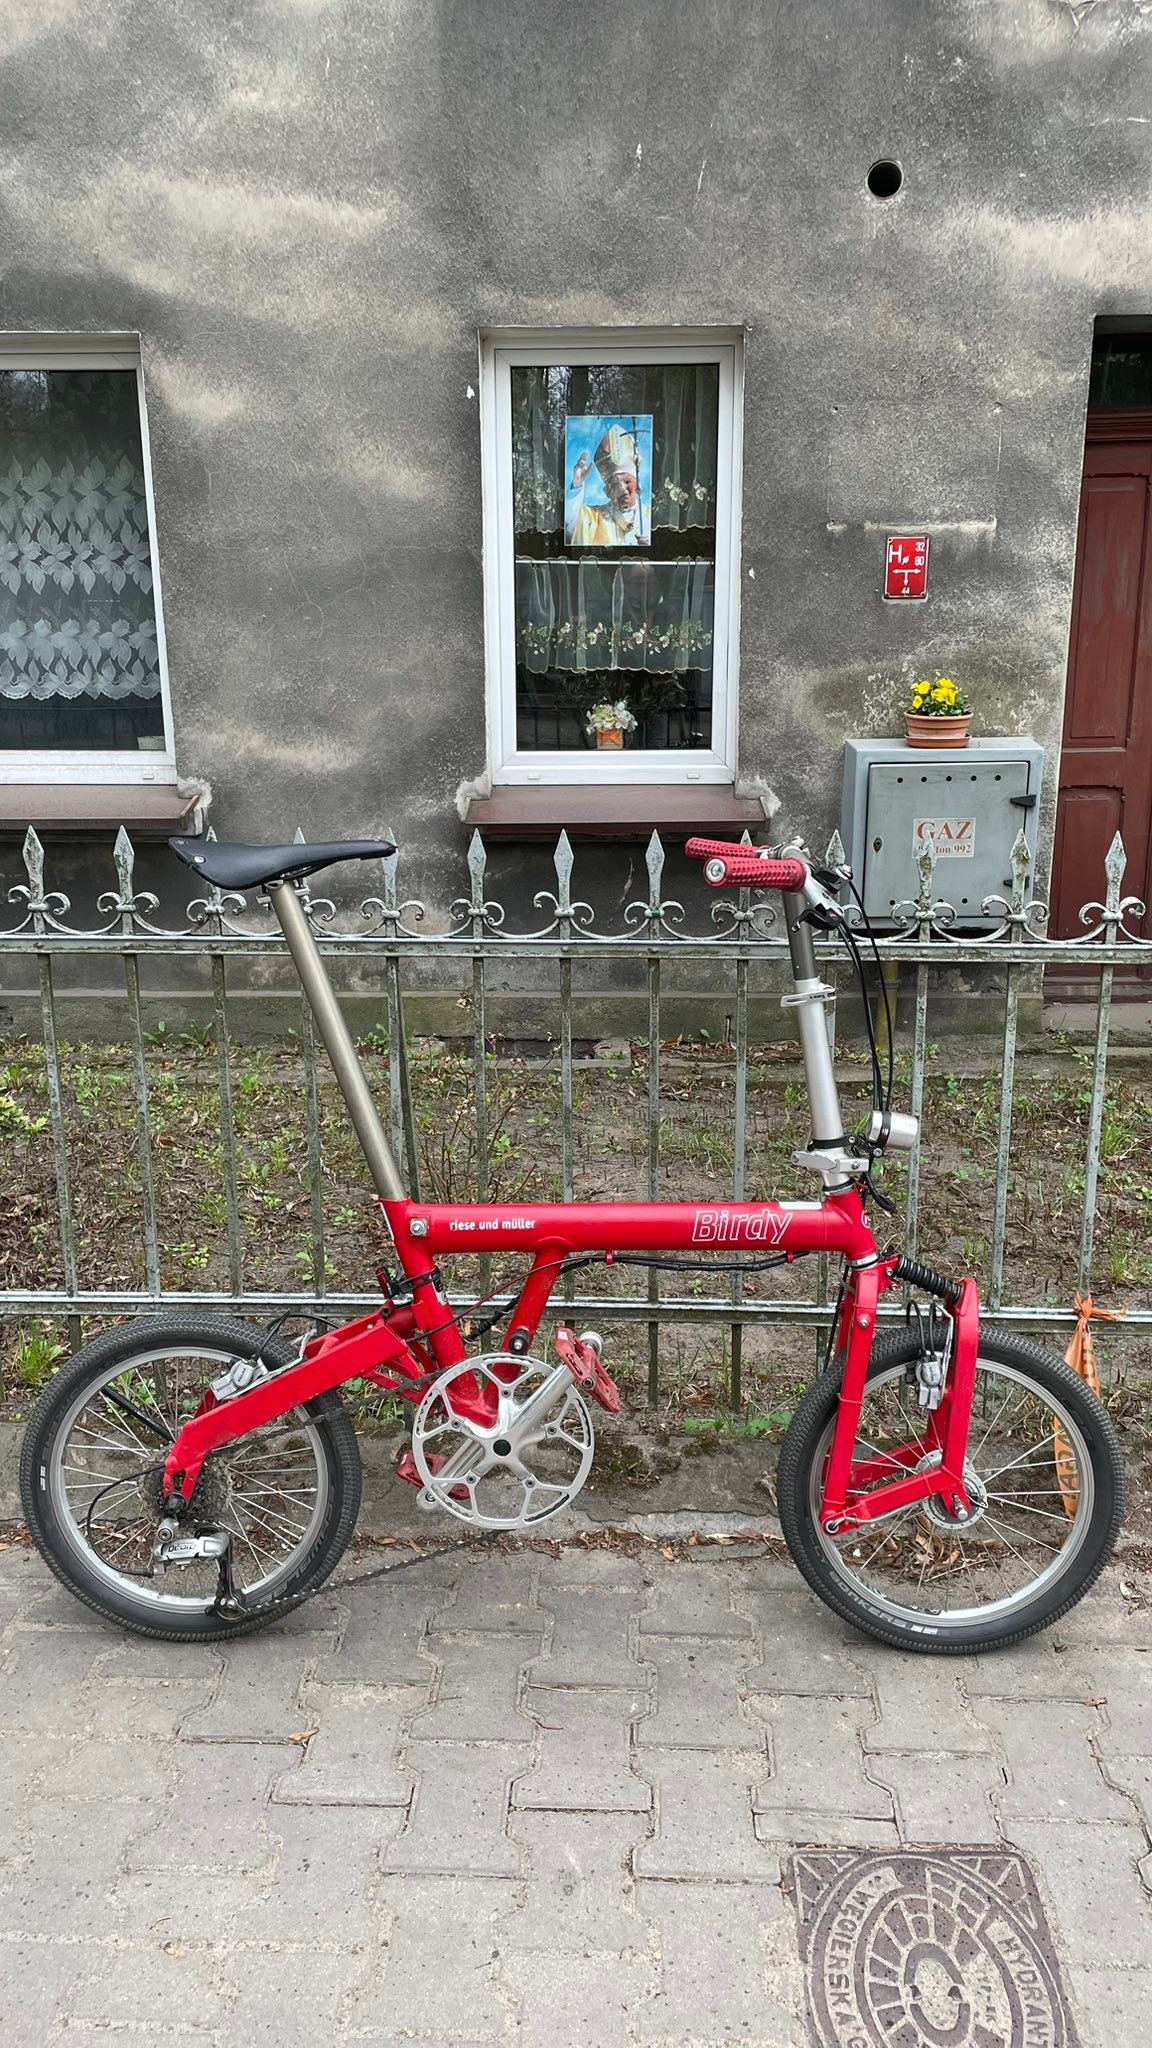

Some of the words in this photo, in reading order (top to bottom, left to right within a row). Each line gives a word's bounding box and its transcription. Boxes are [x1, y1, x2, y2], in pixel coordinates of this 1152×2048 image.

[915, 541, 926, 552] 32
[914, 555, 925, 566] 80
[917, 820, 972, 840] GAZ
[954, 844, 971, 853] 992
[449, 1219, 475, 1231] riese
[479, 1218, 498, 1230] und
[502, 1217, 536, 1230] müller
[692, 1208, 793, 1244] Birdy
[825, 1570, 907, 1628] BONKERS
